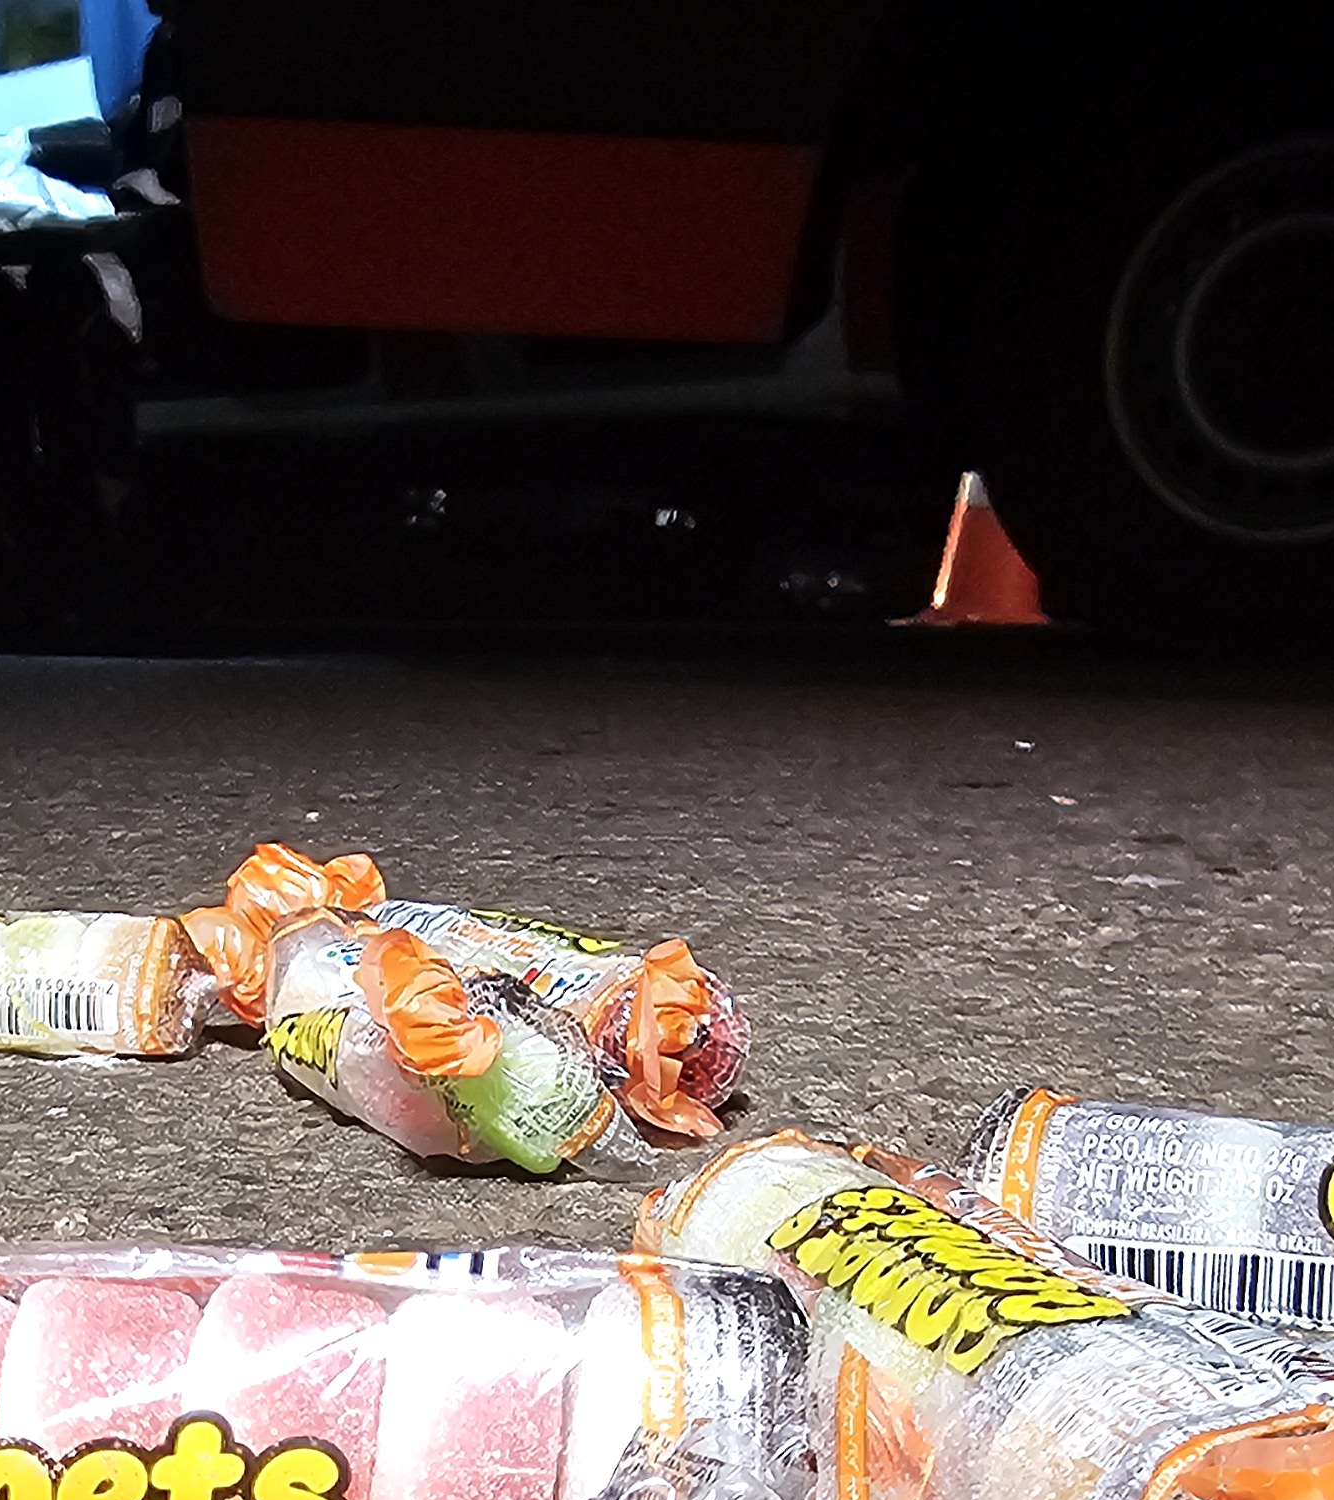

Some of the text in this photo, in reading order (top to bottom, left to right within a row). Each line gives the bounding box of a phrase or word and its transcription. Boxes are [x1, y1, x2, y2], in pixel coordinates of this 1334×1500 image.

[1105, 1113, 1189, 1137] GOMAS
[1082, 1133, 1139, 1161] PESO
[1076, 1160, 1123, 1190] NET
[1124, 1164, 1216, 1198] WEIGHT
